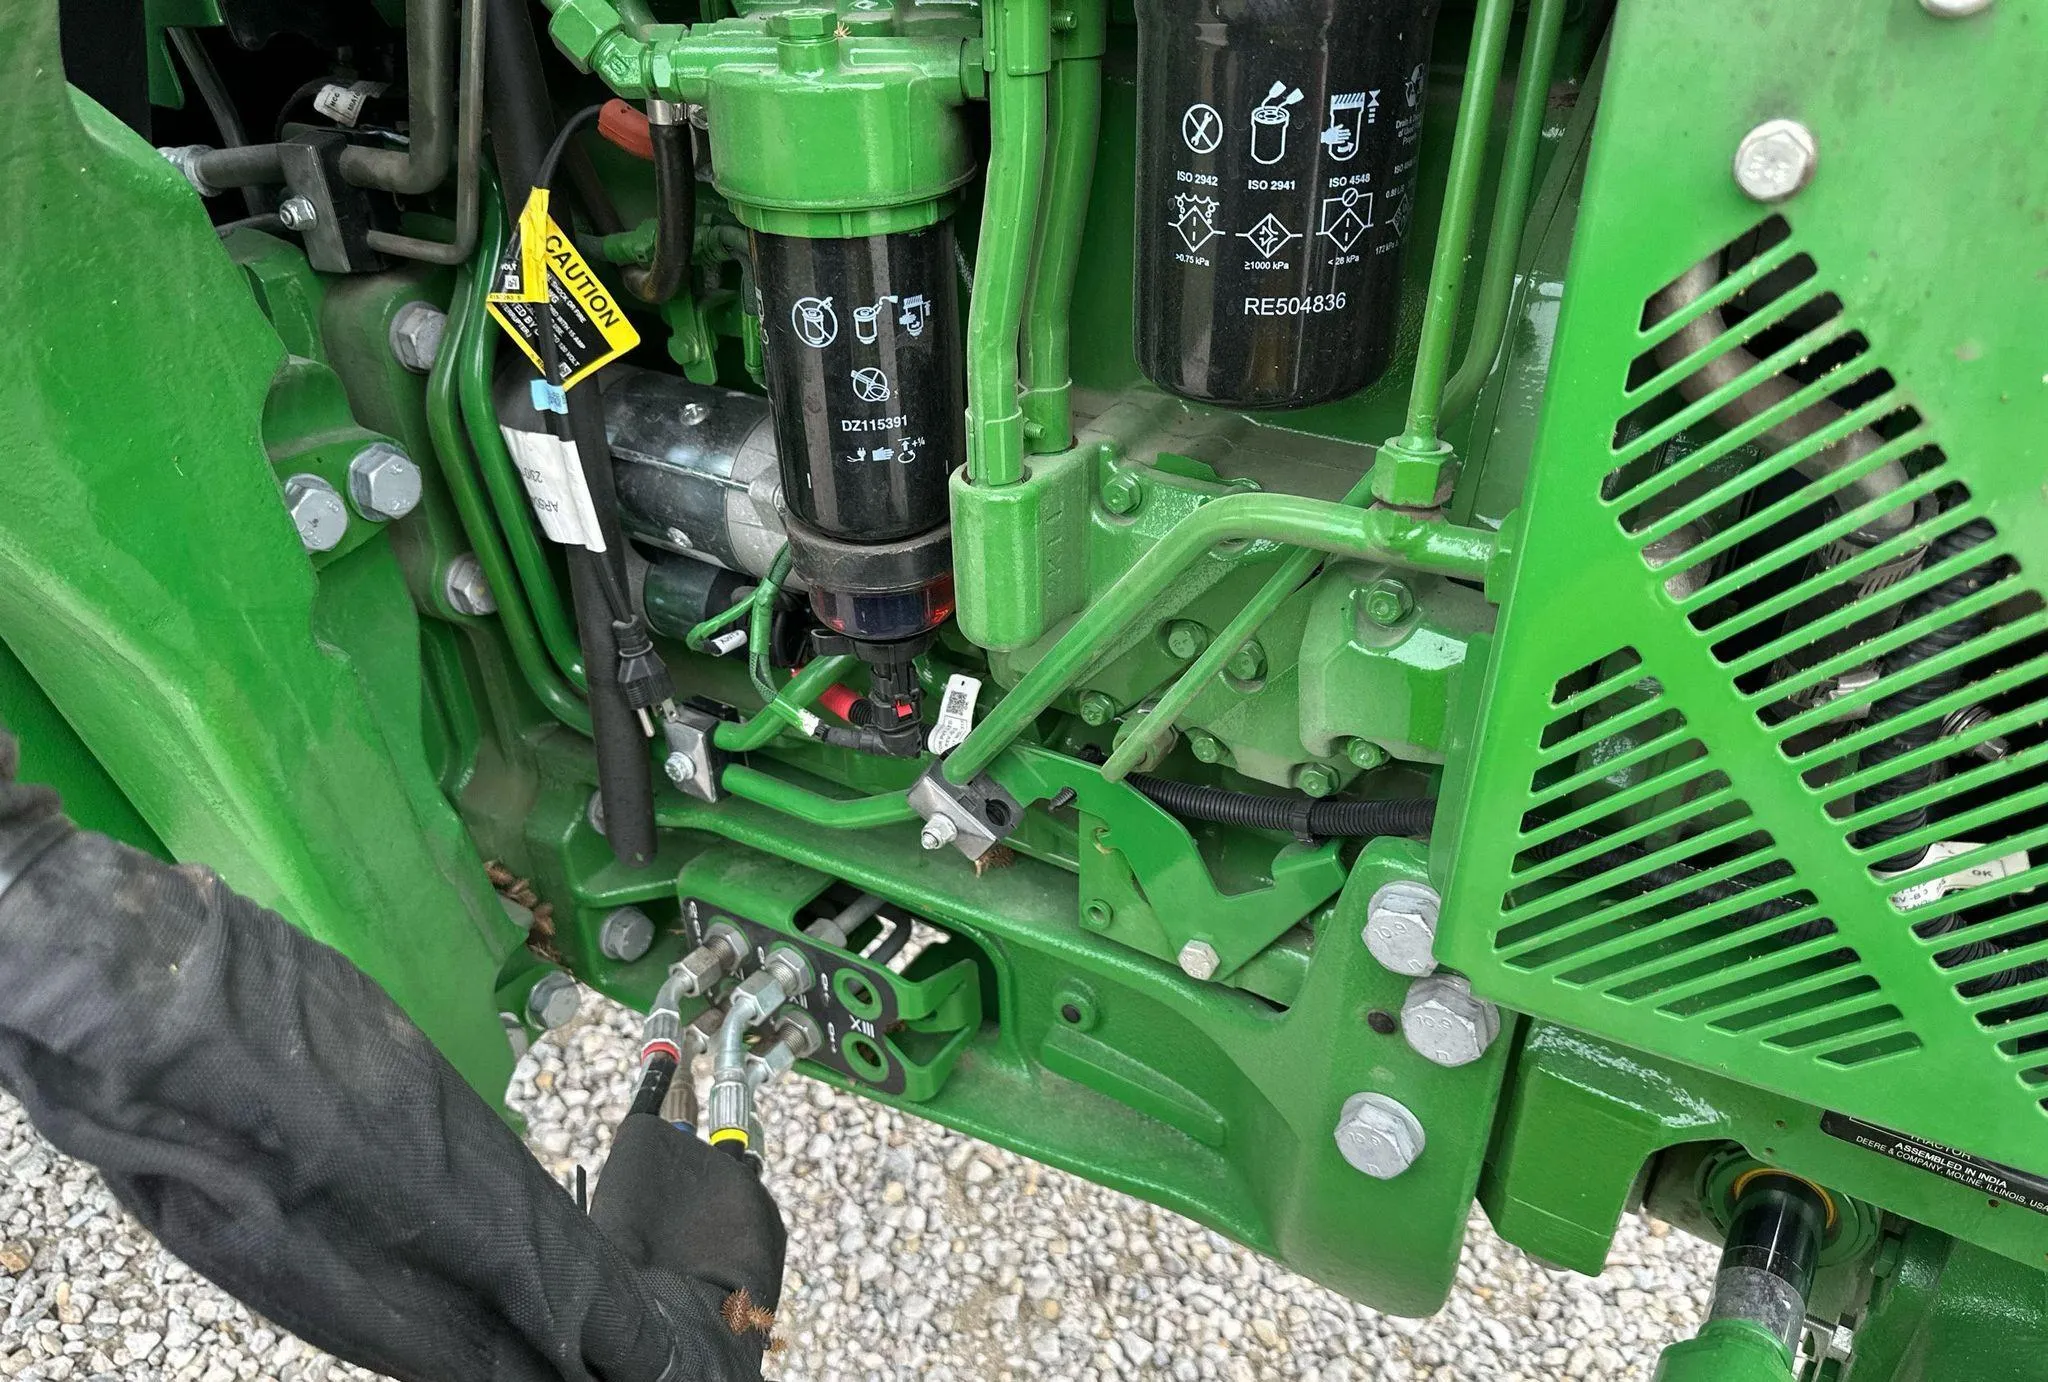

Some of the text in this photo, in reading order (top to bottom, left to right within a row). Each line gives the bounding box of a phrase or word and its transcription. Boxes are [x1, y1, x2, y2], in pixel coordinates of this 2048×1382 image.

[1177, 170, 1219, 187] ISO 2942
[1248, 179, 1296, 190] ISO 2941
[1329, 176, 1347, 188] ISO
[1175, 253, 1210, 267] >0.75 kPa
[1272, 261, 1290, 270] kPa
[1345, 254, 1360, 264] kPa
[546, 235, 621, 329] CAUTION
[551, 280, 588, 325] SHOCK OR FIRE
[1244, 292, 1346, 315] RE504836
[523, 315, 539, 329] BY
[556, 315, 572, 332] WITH
[573, 336, 587, 350] AMP
[565, 351, 581, 367] VOLT
[841, 414, 908, 432] DZ115391
[849, 1014, 875, 1039] XIII
[1855, 1135, 1888, 1152] DEERE
[1887, 1147, 1895, 1156] &
[1896, 1150, 1944, 1174] COMPANY,
[1985, 1183, 2027, 1205] ILLINOIS,
[2029, 1199, 2048, 1213] USA
[1894, 1142, 2007, 1189] ASSEMBLED IN INDIA
